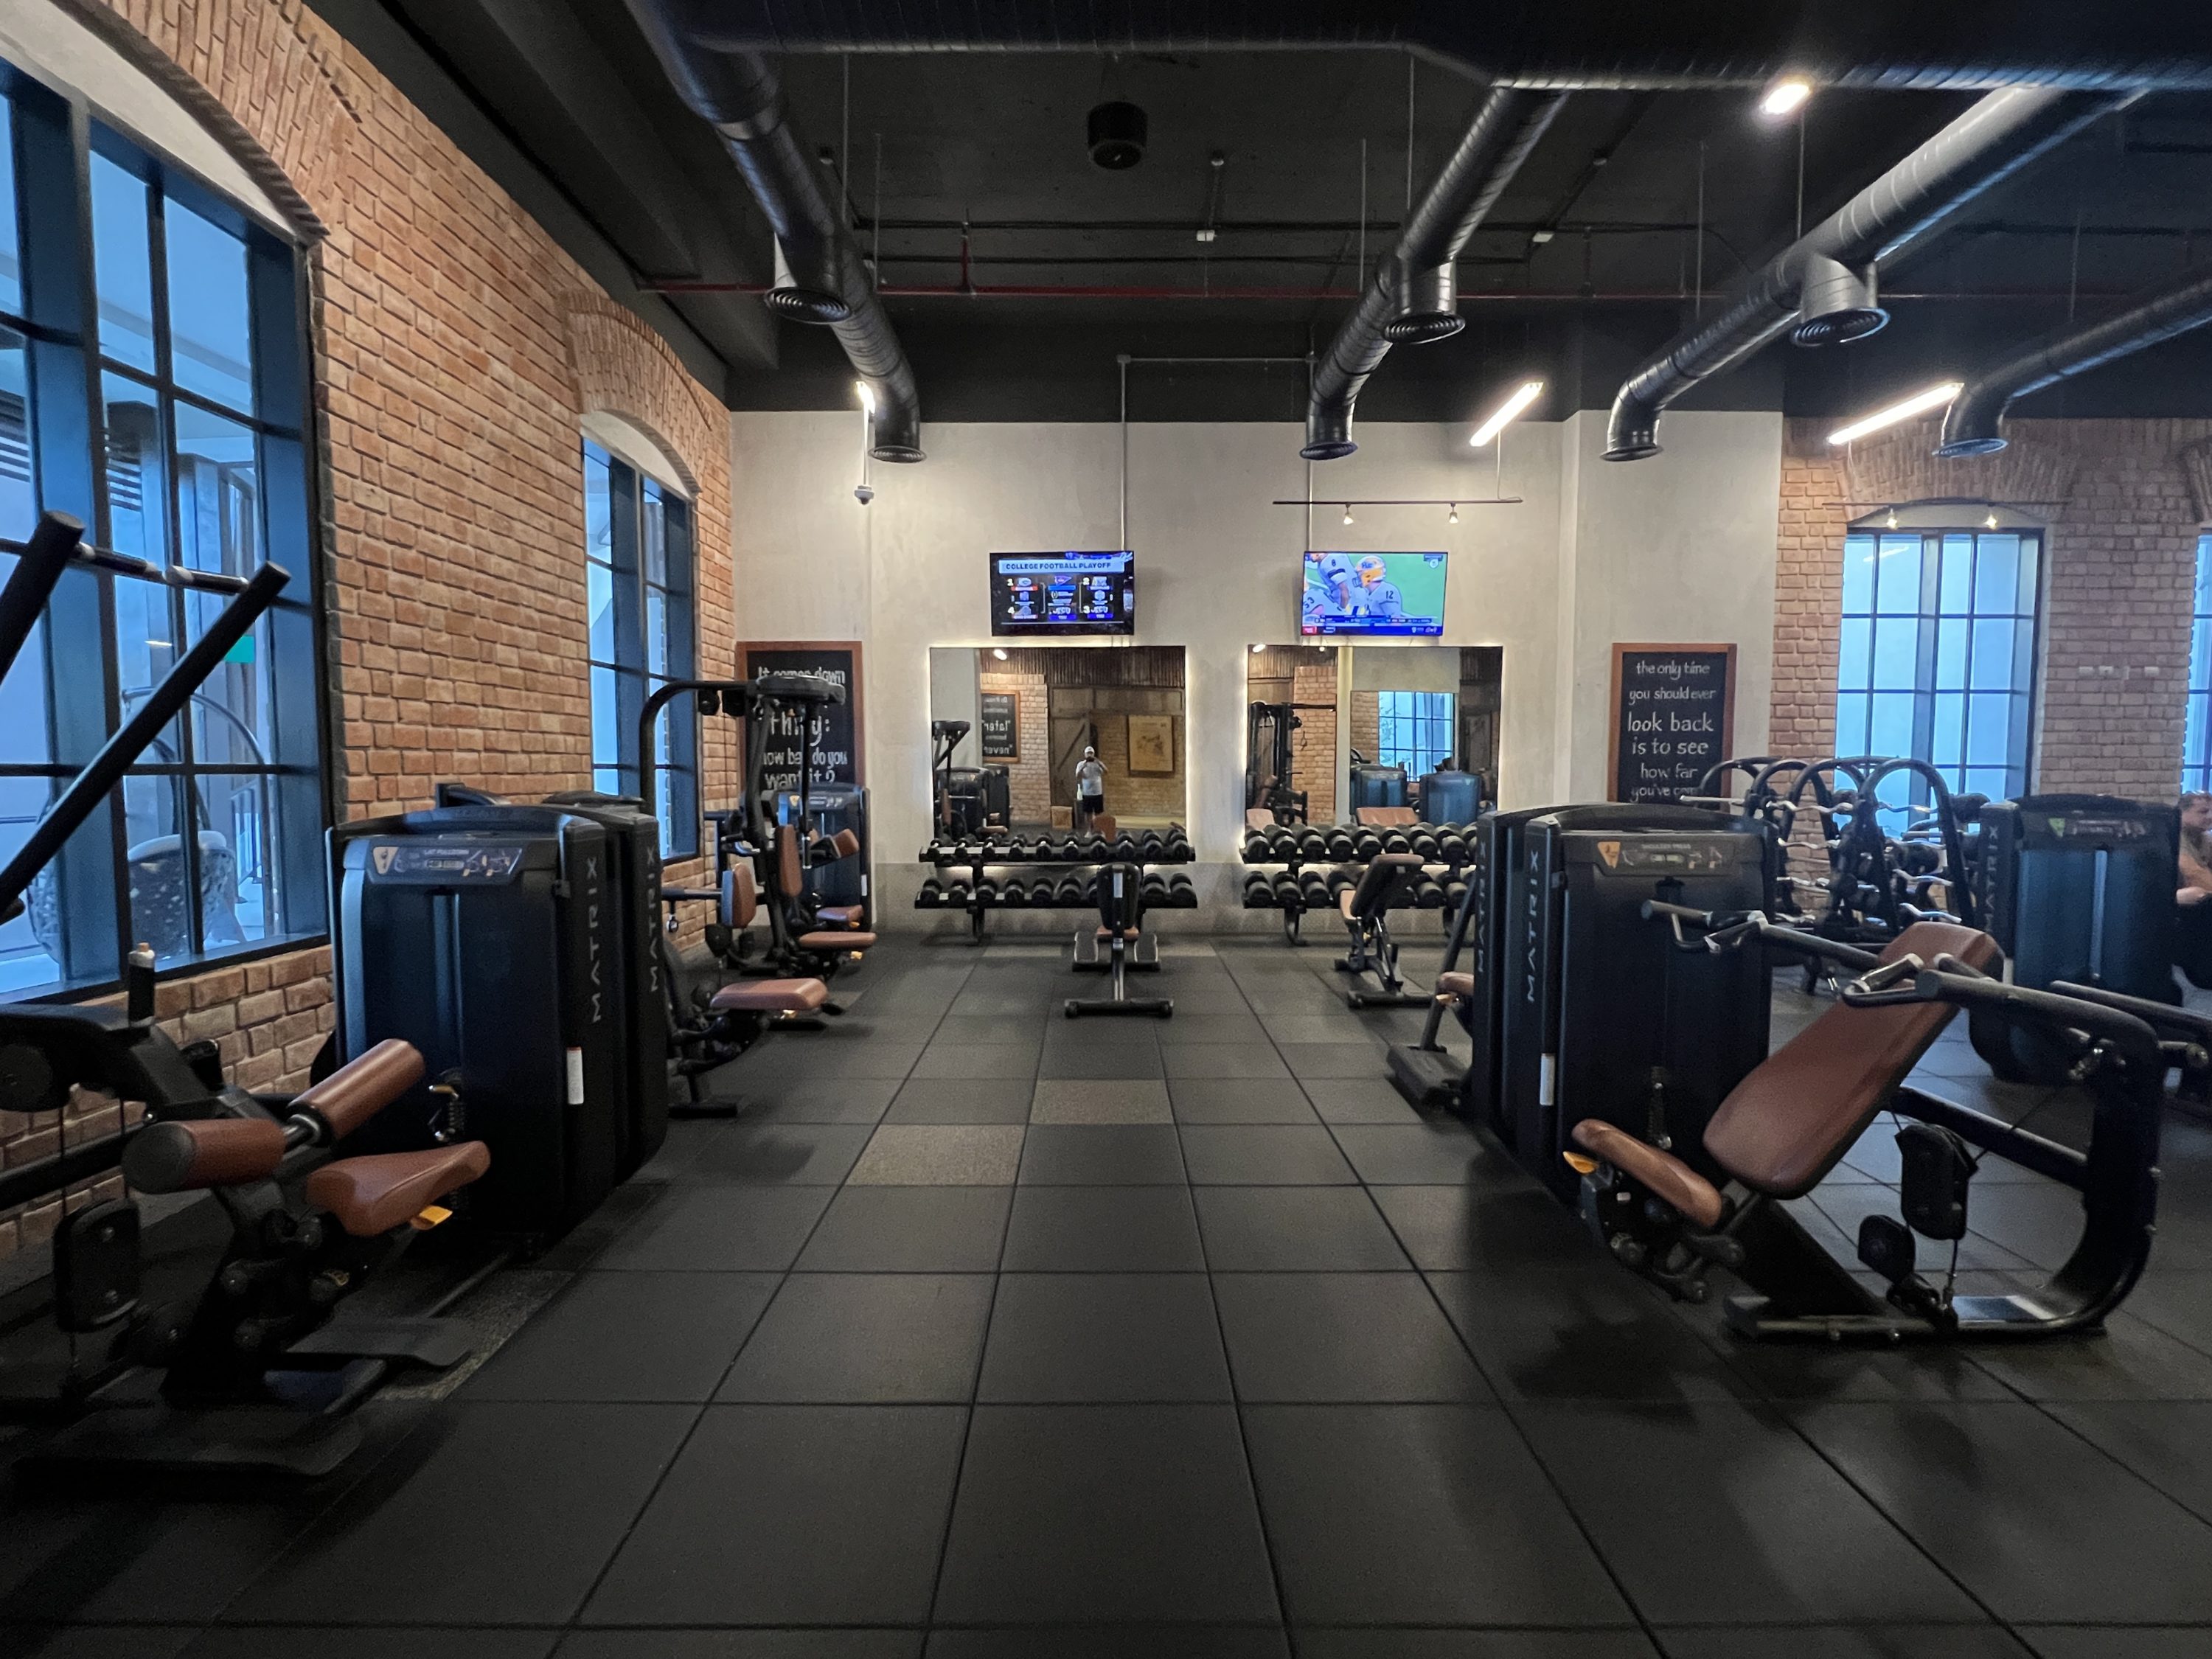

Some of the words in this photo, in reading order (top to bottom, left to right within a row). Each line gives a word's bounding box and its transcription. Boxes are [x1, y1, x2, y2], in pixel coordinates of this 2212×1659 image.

[1006, 578, 1015, 587] 1
[1082, 577, 1091, 585] 2
[1385, 590, 1395, 600] 12
[1007, 605, 1015, 614] 4
[1082, 605, 1091, 614] 3
[1636, 660, 1656, 675] the
[1657, 660, 1681, 681] only
[1683, 661, 1711, 675] time
[1628, 689, 1651, 706] you
[1653, 686, 1690, 700] should
[1690, 690, 1717, 700] ever
[1628, 711, 1663, 731] look
[1670, 711, 1714, 731] back
[1632, 736, 1646, 755] is
[1651, 737, 1672, 754] to
[1676, 742, 1709, 755] see
[787, 747, 802, 765] ba
[812, 746, 826, 765] do
[827, 751, 848, 769] you
[1641, 762, 1671, 779] how
[1675, 762, 1698, 779] far
[646, 846, 658, 992] MATRIX
[1527, 850, 1539, 1003] MATRIX
[587, 856, 602, 1023] MATRIX
